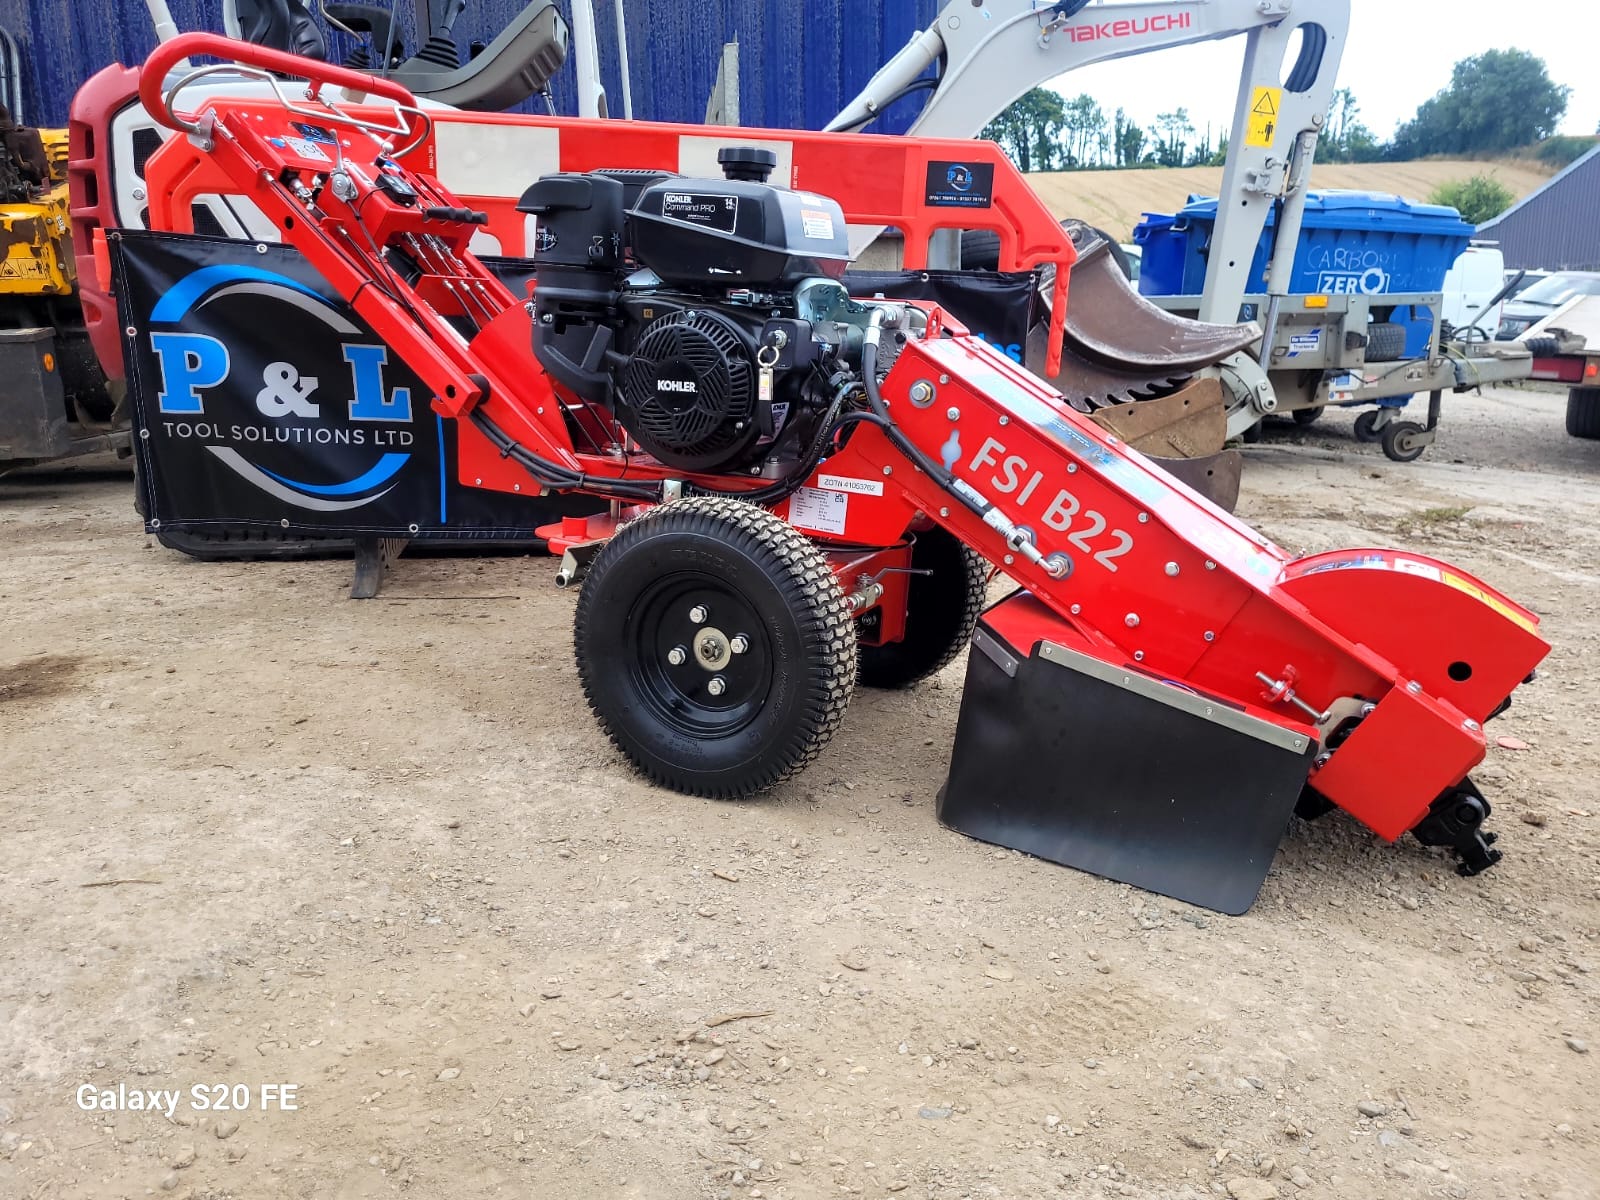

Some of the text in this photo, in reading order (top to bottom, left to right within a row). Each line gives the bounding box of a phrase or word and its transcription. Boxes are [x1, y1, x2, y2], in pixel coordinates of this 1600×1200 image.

[664, 203, 698, 212] Command
[701, 205, 716, 213] PRO
[666, 196, 692, 204] KOHLER
[150, 332, 413, 422] P & L
[163, 422, 414, 446] TOOL SOLUTIONS LTD
[969, 437, 1043, 506] FSI
[1041, 489, 1134, 572] B22
